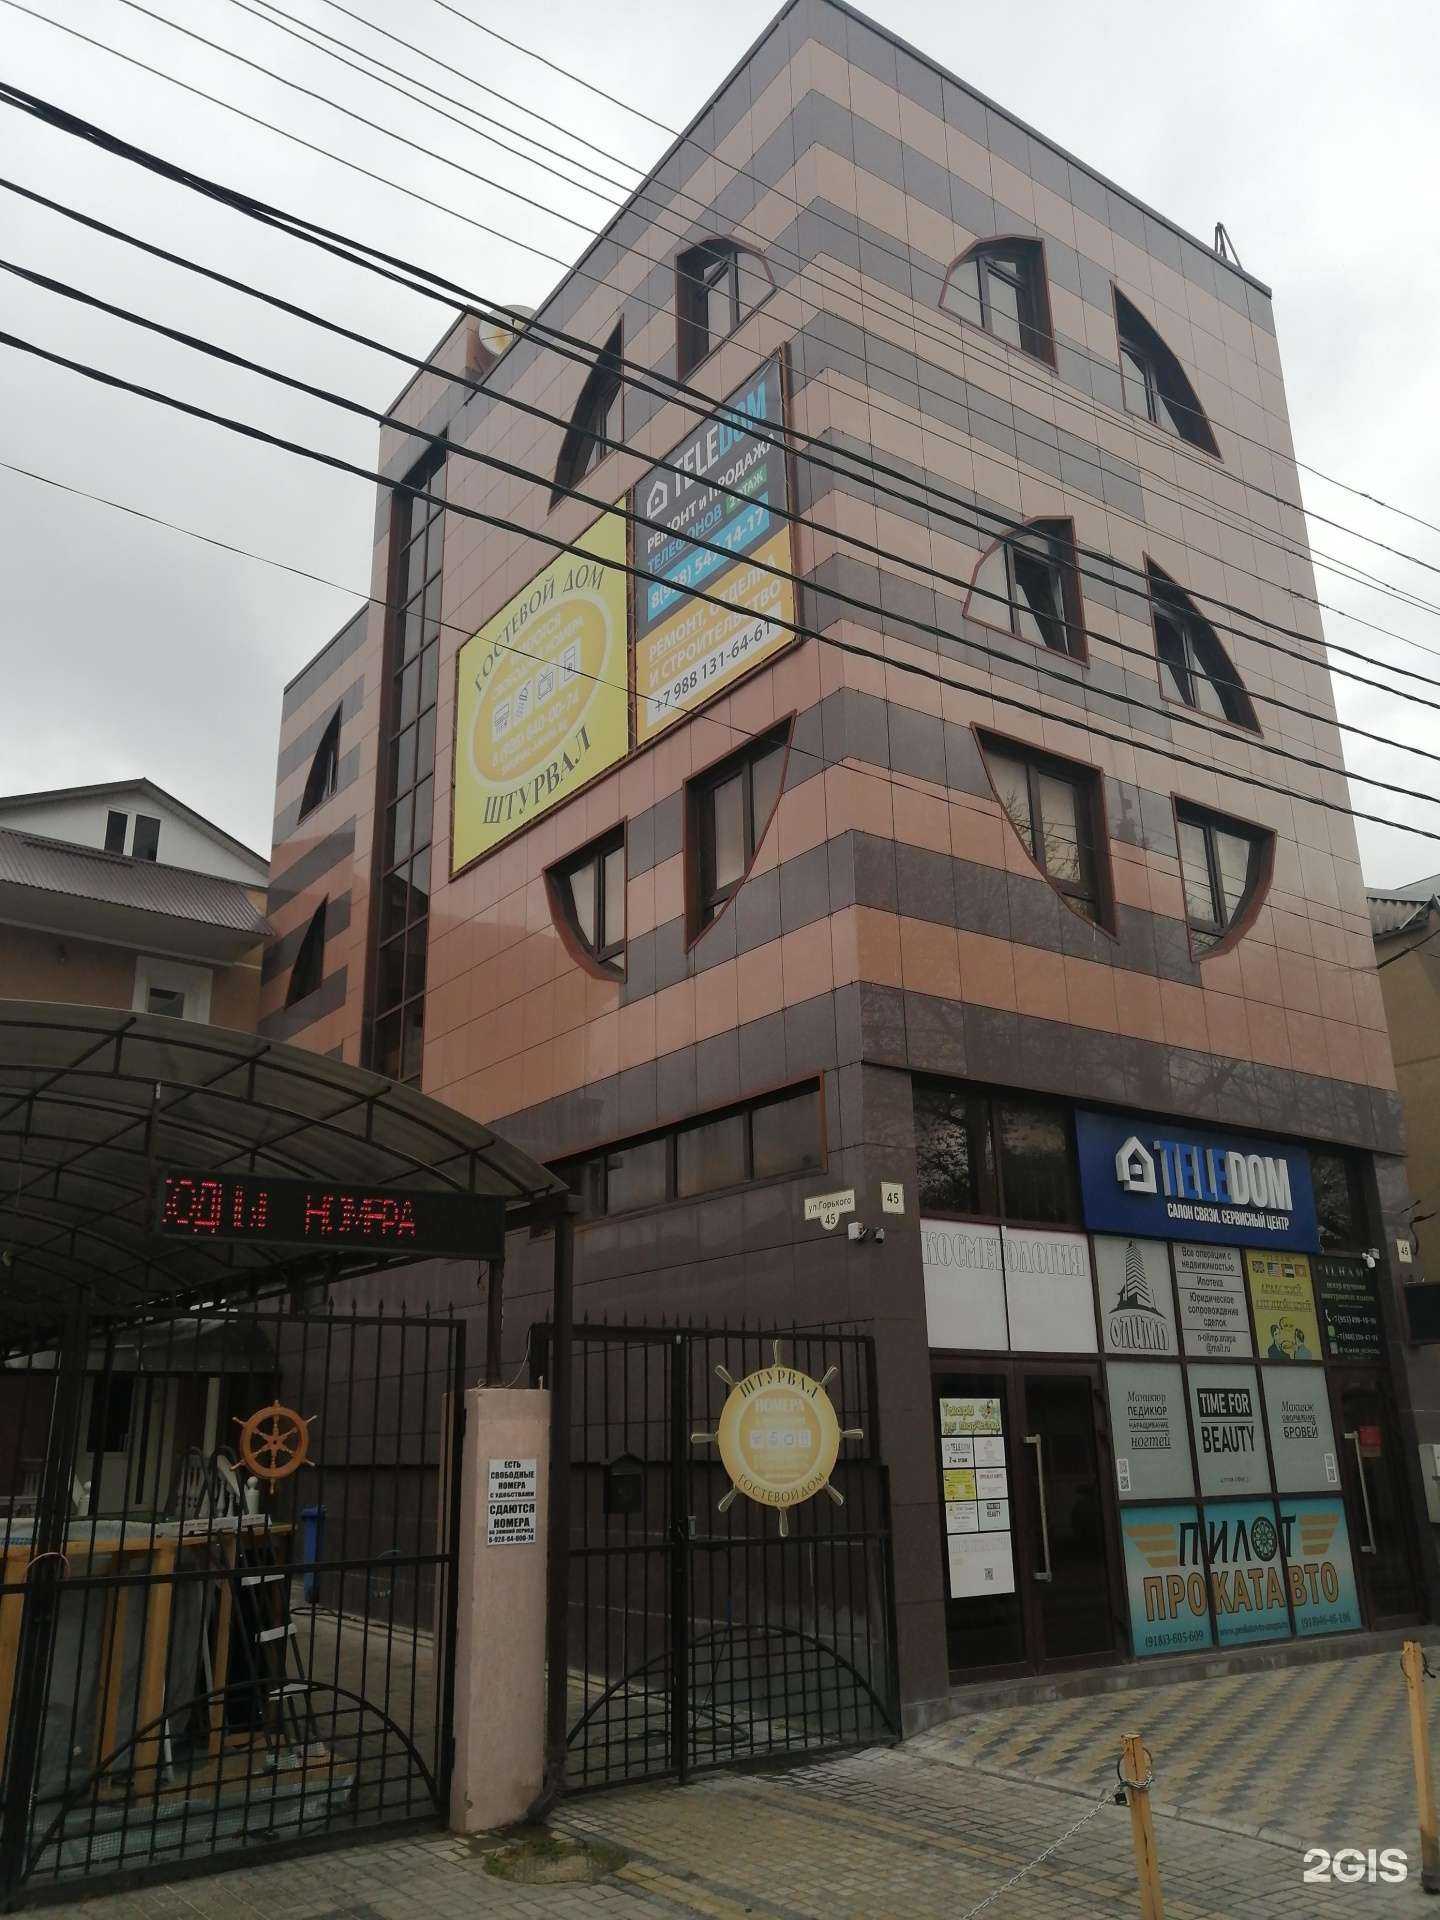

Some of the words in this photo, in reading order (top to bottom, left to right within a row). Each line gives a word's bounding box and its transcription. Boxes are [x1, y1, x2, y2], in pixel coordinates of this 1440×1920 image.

[474, 575, 555, 692] ГОСТЕВОЙ
[563, 565, 606, 593] ДОМ
[673, 671, 698, 700] 988
[701, 621, 772, 680] 131-64-61
[483, 726, 591, 824] ШТУРВАЛ
[1153, 1140, 1293, 1211] TELEDOM
[818, 1197, 852, 1210] Горького
[886, 1192, 899, 1205] 45
[824, 1213, 836, 1225] 45
[1167, 1203, 1194, 1220] САЛОН
[1221, 1210, 1265, 1229] СЕРВИСНЫЙ
[1266, 1216, 1290, 1231] ЦЕНТР
[739, 1370, 818, 1398] ШТУРВАЛ
[1200, 1393, 1226, 1414] TIME
[1228, 1393, 1250, 1414] FOR
[1127, 1406, 1168, 1418] ПЕДИКЮР
[1201, 1426, 1255, 1453] BEAUTY
[504, 1461, 521, 1469] ЕСТЬ
[490, 1471, 535, 1480] СВОБОДНЫЕ
[498, 1481, 526, 1490] НОМЕРА
[489, 1503, 535, 1515] СДАЮТСЯ
[493, 1518, 530, 1528] НОМЕРА
